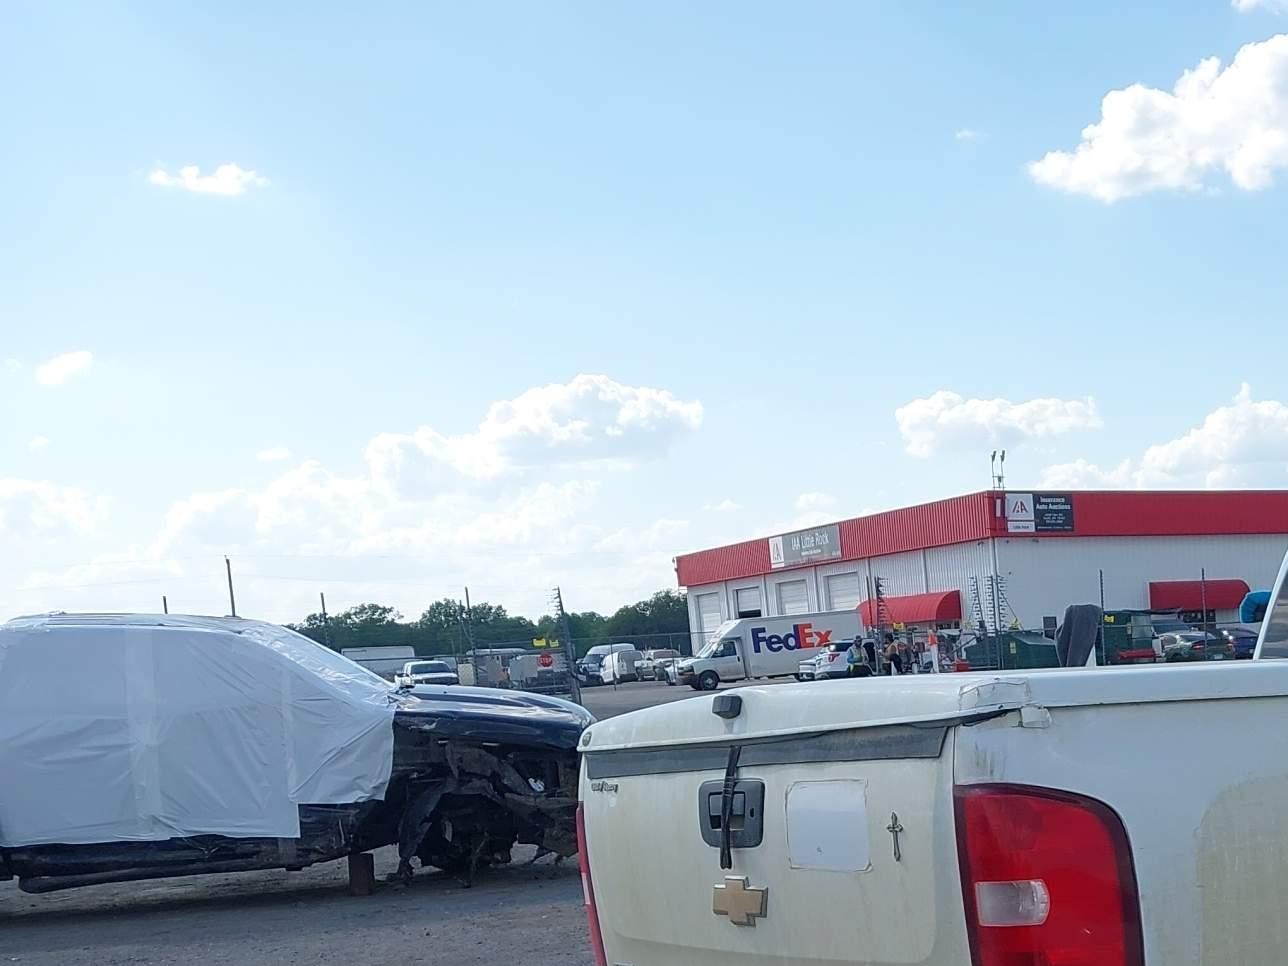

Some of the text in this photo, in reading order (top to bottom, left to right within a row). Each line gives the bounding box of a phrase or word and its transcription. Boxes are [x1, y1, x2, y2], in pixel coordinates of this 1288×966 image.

[800, 534, 815, 549] Little
[815, 530, 829, 546] Rock
[751, 623, 833, 654] FedEx
